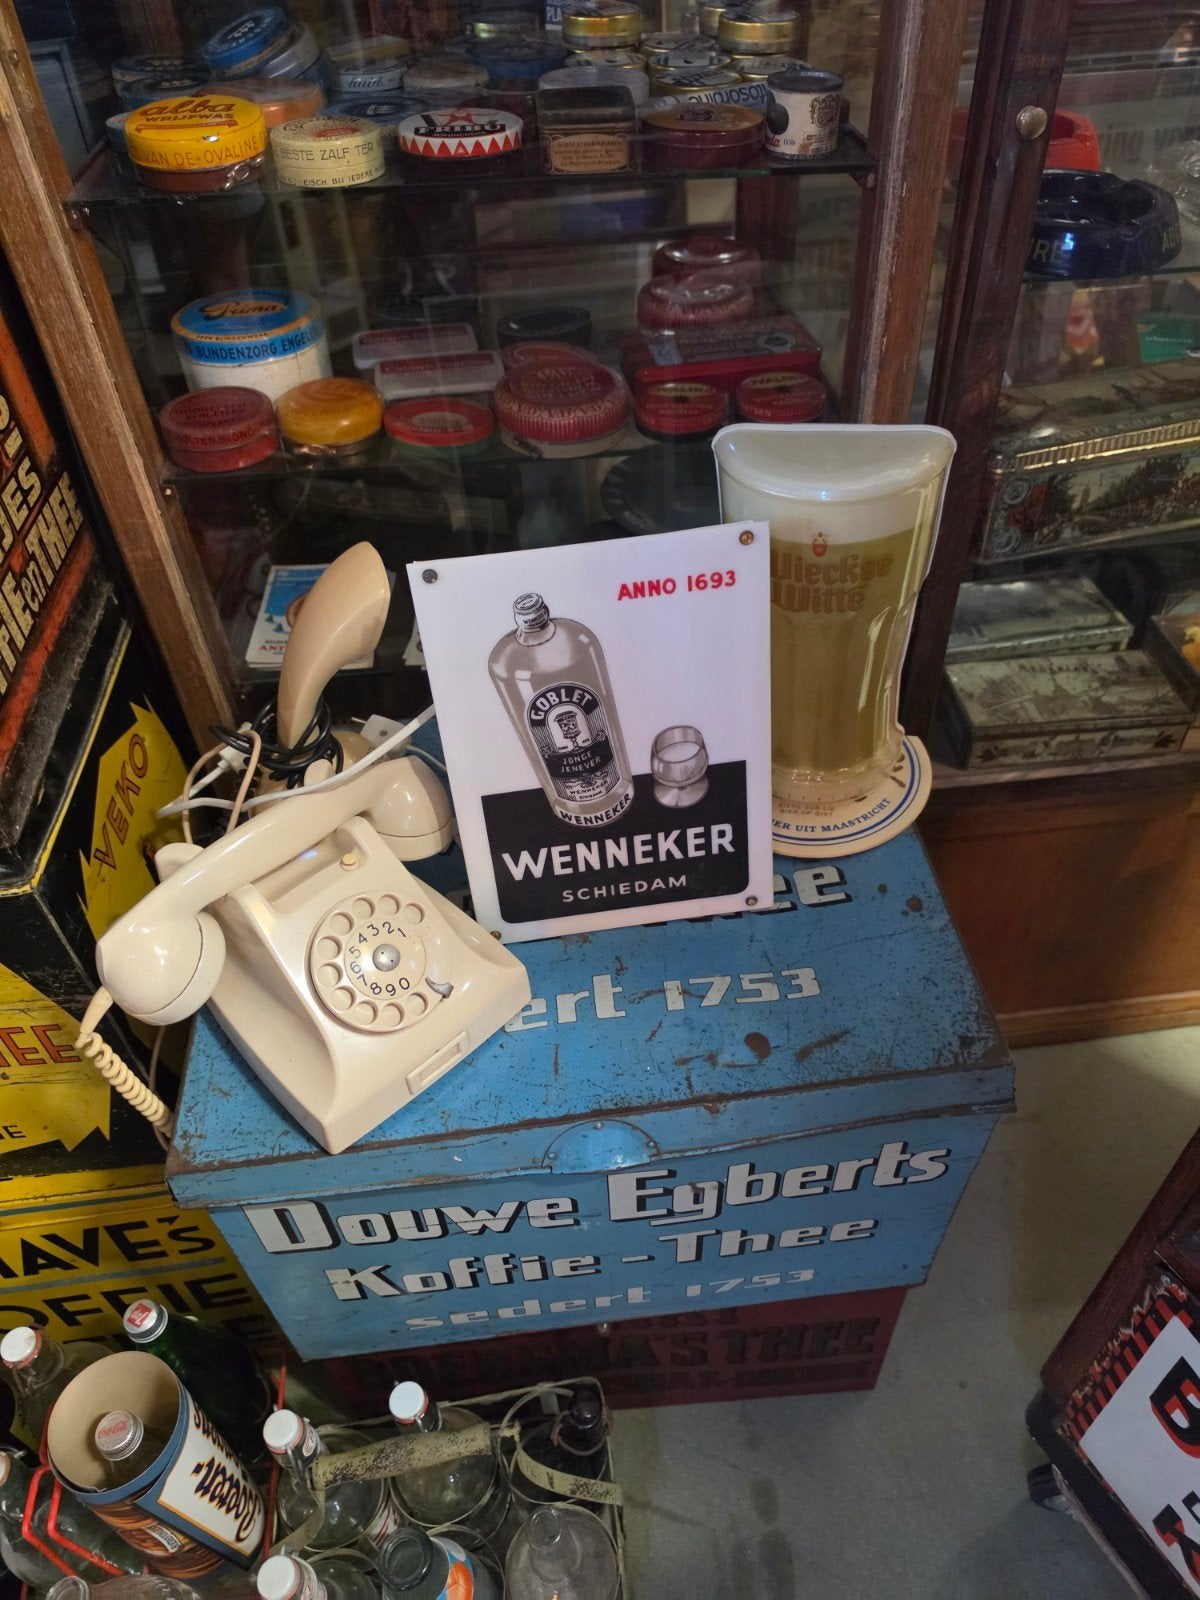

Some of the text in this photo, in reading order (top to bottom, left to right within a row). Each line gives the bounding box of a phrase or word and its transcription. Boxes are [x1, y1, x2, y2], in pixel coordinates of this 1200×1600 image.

[139, 99, 236, 117] alba
[145, 113, 234, 123] WRIJFWAS
[175, 151, 195, 166] DE
[203, 136, 259, 163] OVALINE
[320, 147, 350, 161] ZALF
[195, 343, 277, 360] BLINDENZORG
[25, 470, 85, 587] THEE
[618, 570, 736, 601] ANNO 1693
[530, 688, 593, 720] GOBLET
[560, 756, 602, 773] JENEVER
[562, 751, 593, 765] JONGE
[93, 733, 150, 872] VEKO
[559, 793, 632, 826] WENNEKER
[795, 825, 817, 833] UIT
[821, 797, 891, 832] MAASTRICHT
[501, 822, 736, 882] WENNEKER
[562, 874, 688, 904] SCHIEDAM
[348, 921, 410, 996] 1 2 3 4 5 6 7 8 9 0
[663, 966, 822, 1012] 1753
[242, 1140, 951, 1254] Douwe Egberts
[324, 1252, 601, 1301] Koffie
[657, 1217, 880, 1264] Thee
[404, 1284, 653, 1331] sedert
[685, 1268, 816, 1298] 1753
